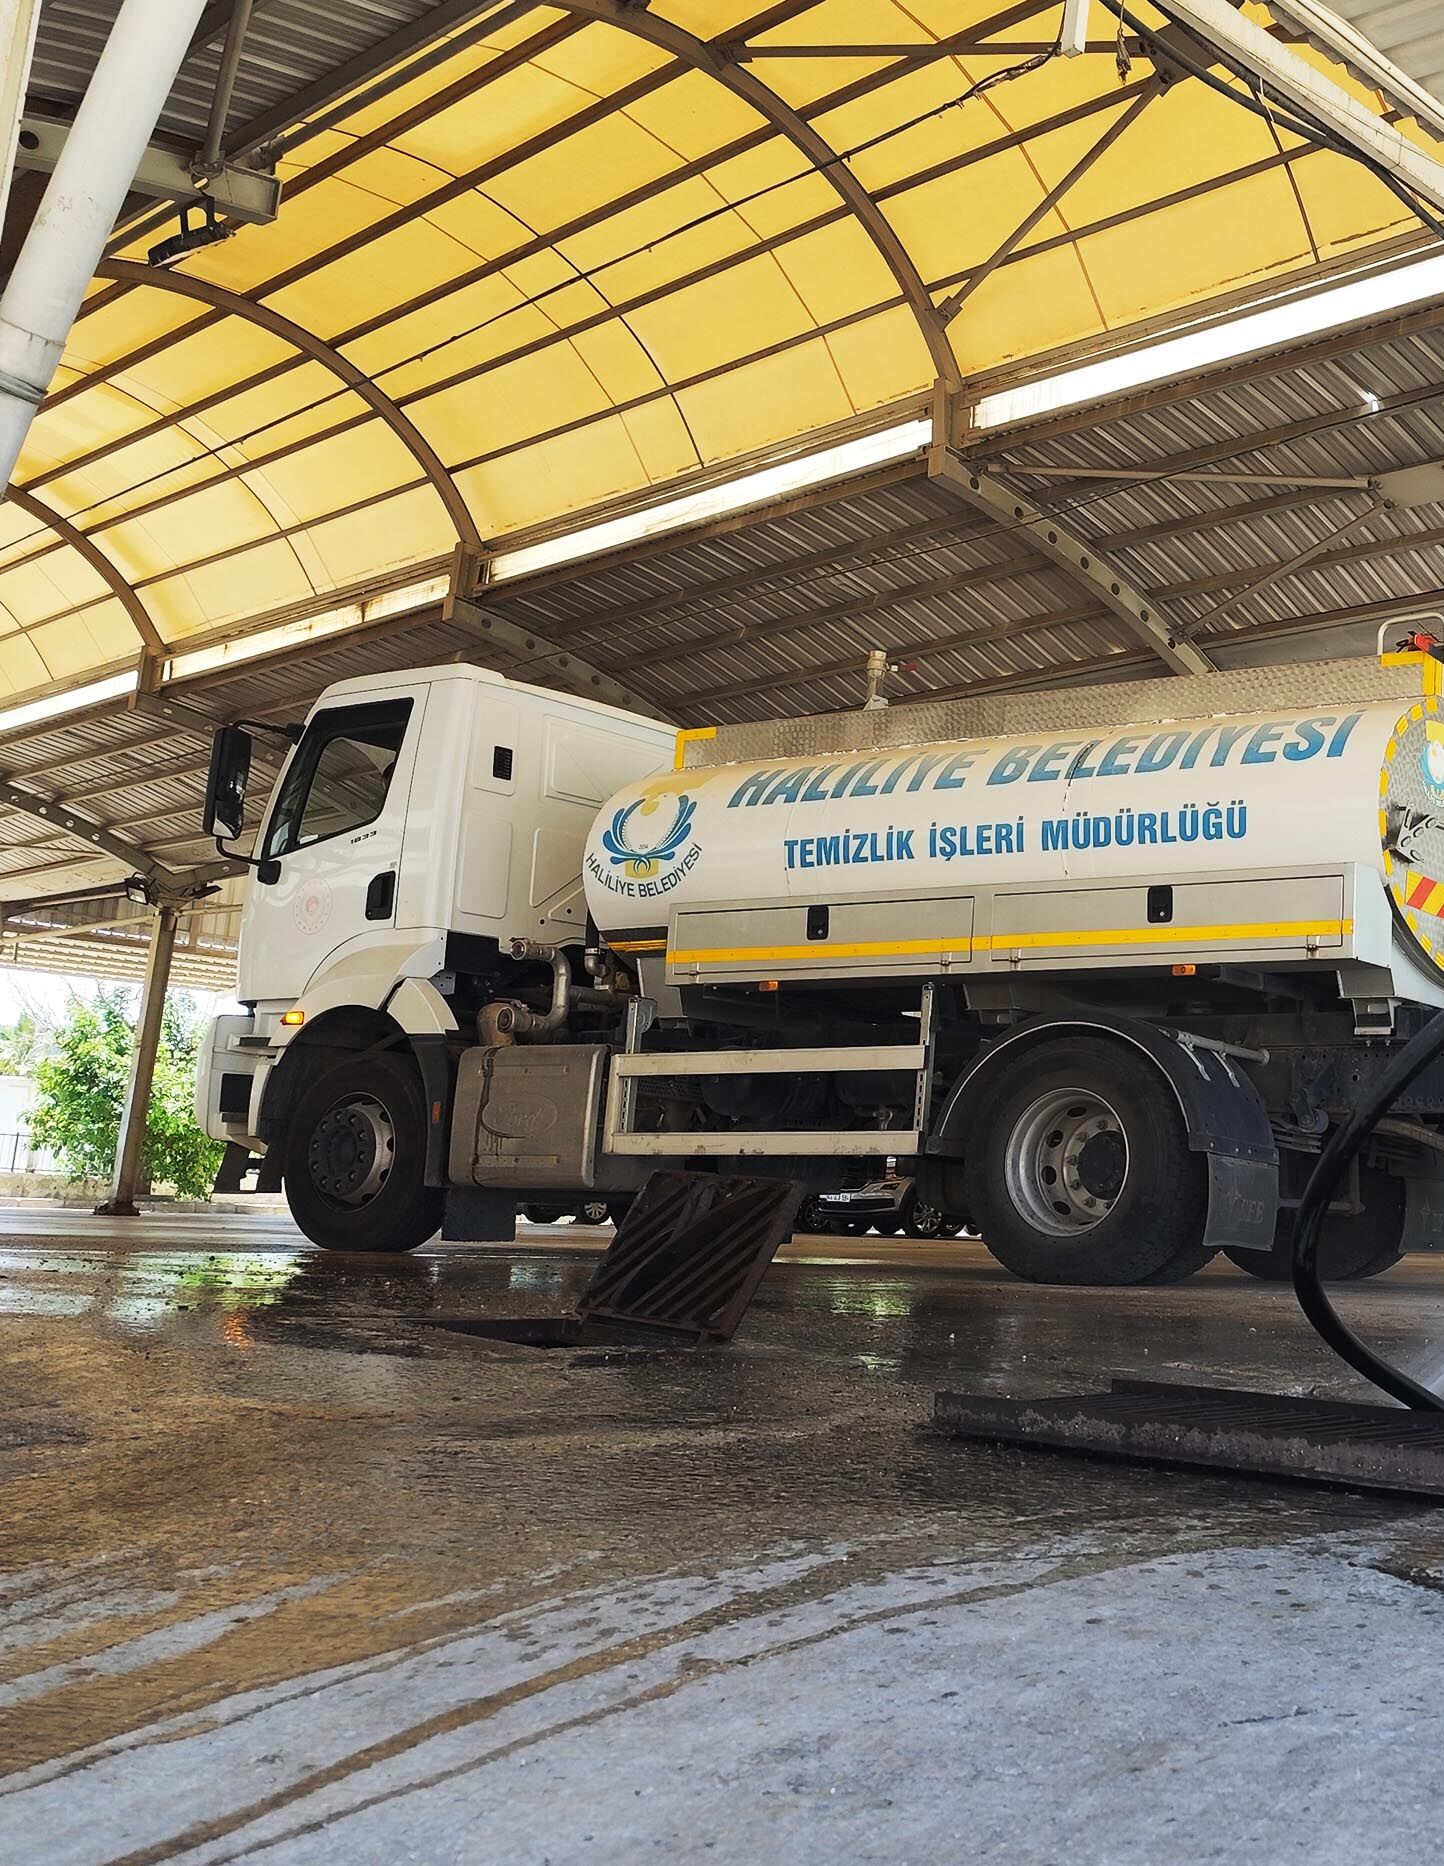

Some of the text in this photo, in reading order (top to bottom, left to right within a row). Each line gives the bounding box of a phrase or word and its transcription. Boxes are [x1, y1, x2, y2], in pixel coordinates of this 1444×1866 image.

[727, 709, 1367, 807] HALİLİYE BELEDİYESİ
[784, 800, 1247, 869] TEMİZLİK İŞLERİ MÜDÜRLÜĞÜ
[586, 842, 702, 897] HALİLİYE BELEDİYESİ
